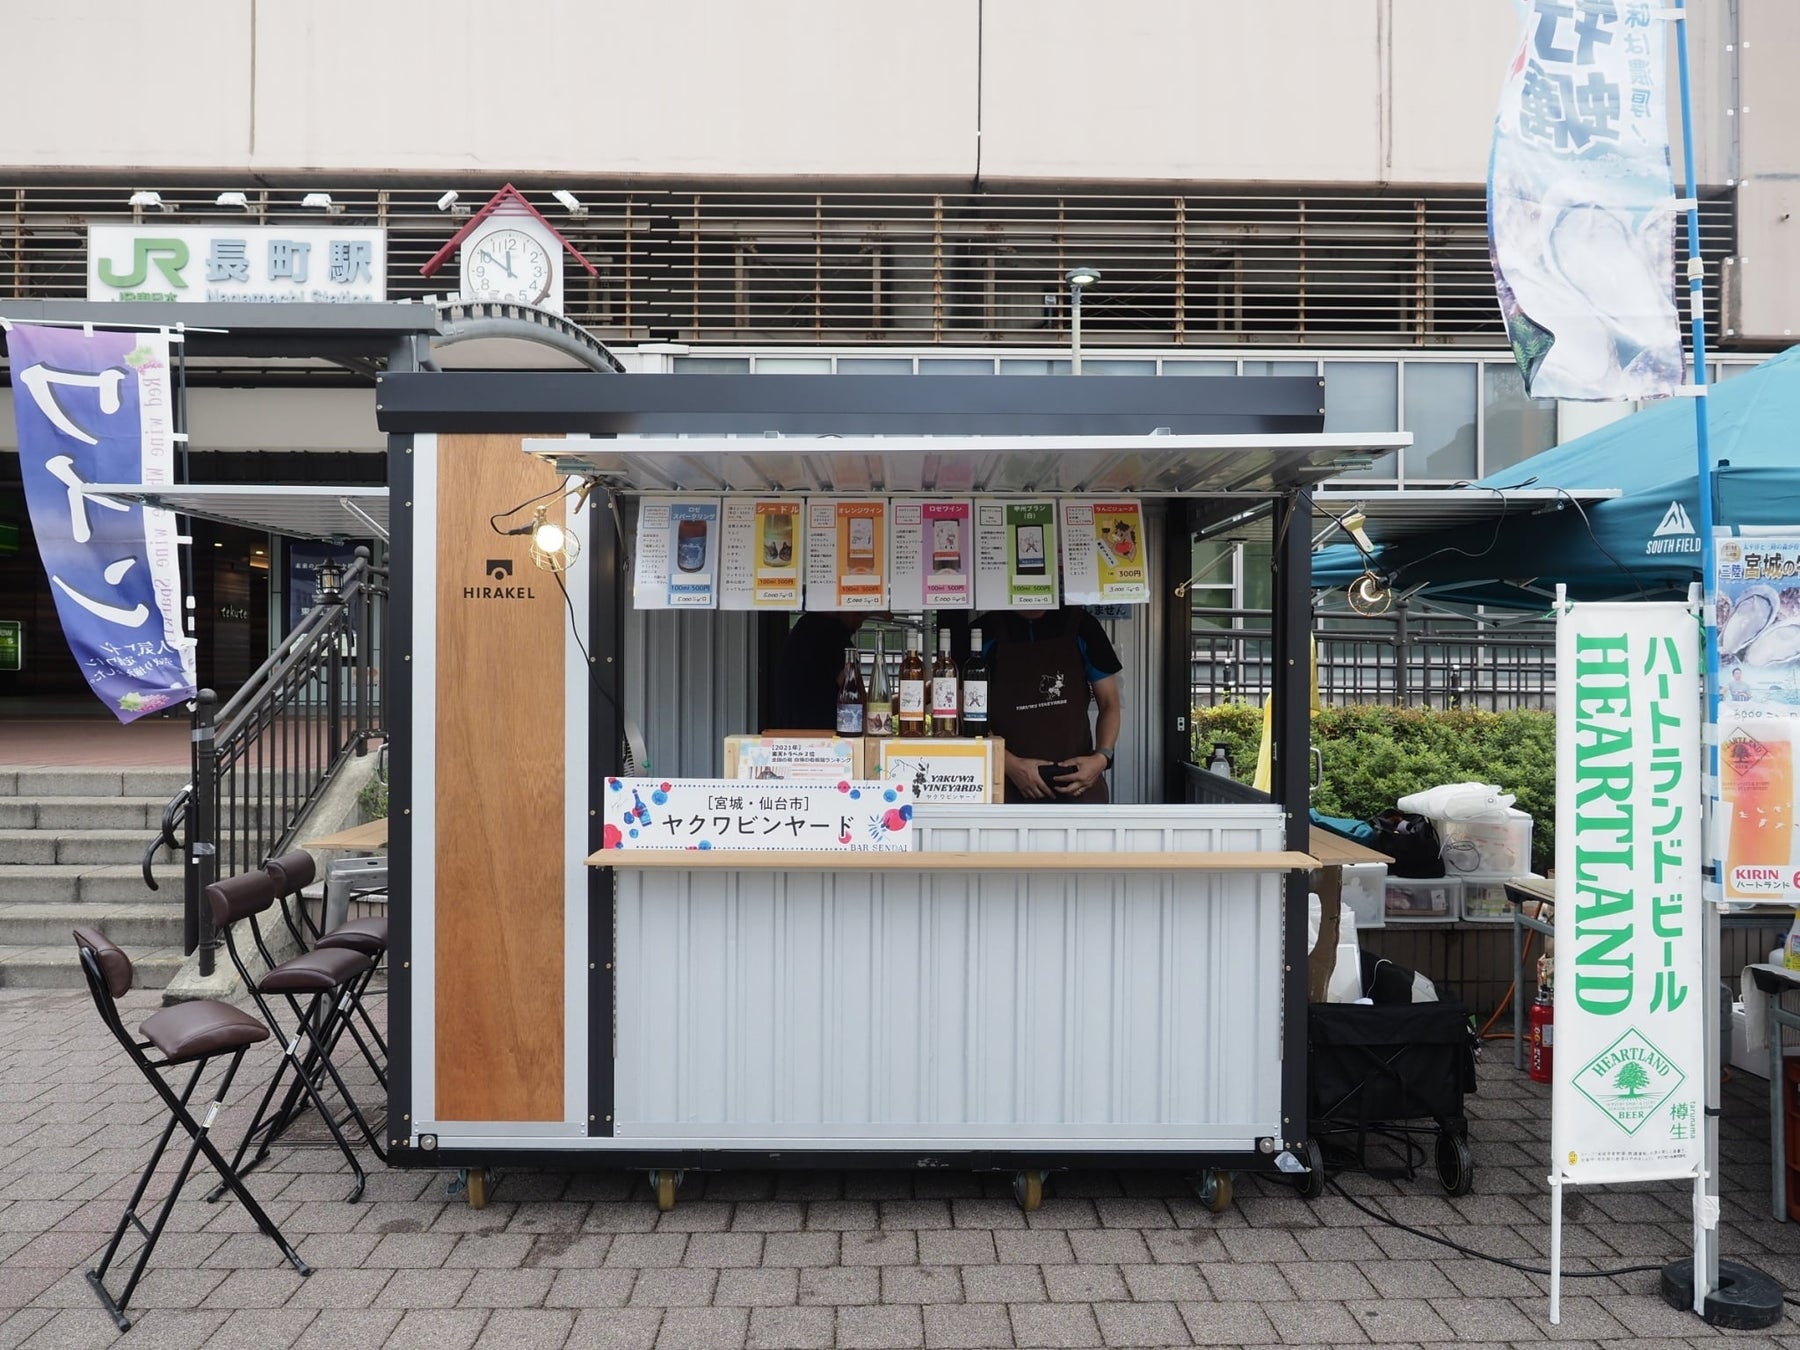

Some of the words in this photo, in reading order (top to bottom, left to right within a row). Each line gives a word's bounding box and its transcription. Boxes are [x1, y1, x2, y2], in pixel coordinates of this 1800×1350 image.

[504, 238, 517, 250] 12
[98, 238, 190, 288] JR
[206, 239, 373, 283] 長町駅
[1645, 539, 1675, 555] SOUTH
[1675, 537, 1701, 553] FIELD
[1744, 553, 1800, 579] 宮城の
[463, 586, 536, 599] HIRAKEL
[923, 784, 984, 792] VINEYARDS
[931, 775, 975, 783] YAKUWA
[661, 813, 854, 837] ヤクワビンヤード
[1575, 633, 1635, 1016] HEARTLAND
[1643, 636, 1689, 1015] ハートランドビール
[850, 843, 867, 852] BAR
[869, 843, 908, 852] SENDAI
[1736, 869, 1779, 880] KIRIN
[1736, 881, 1790, 889] ハートランド
[1591, 1047, 1671, 1078] HEARTLAND
[1618, 1111, 1645, 1119] BEER
[1669, 1103, 1689, 1141] 樽生
